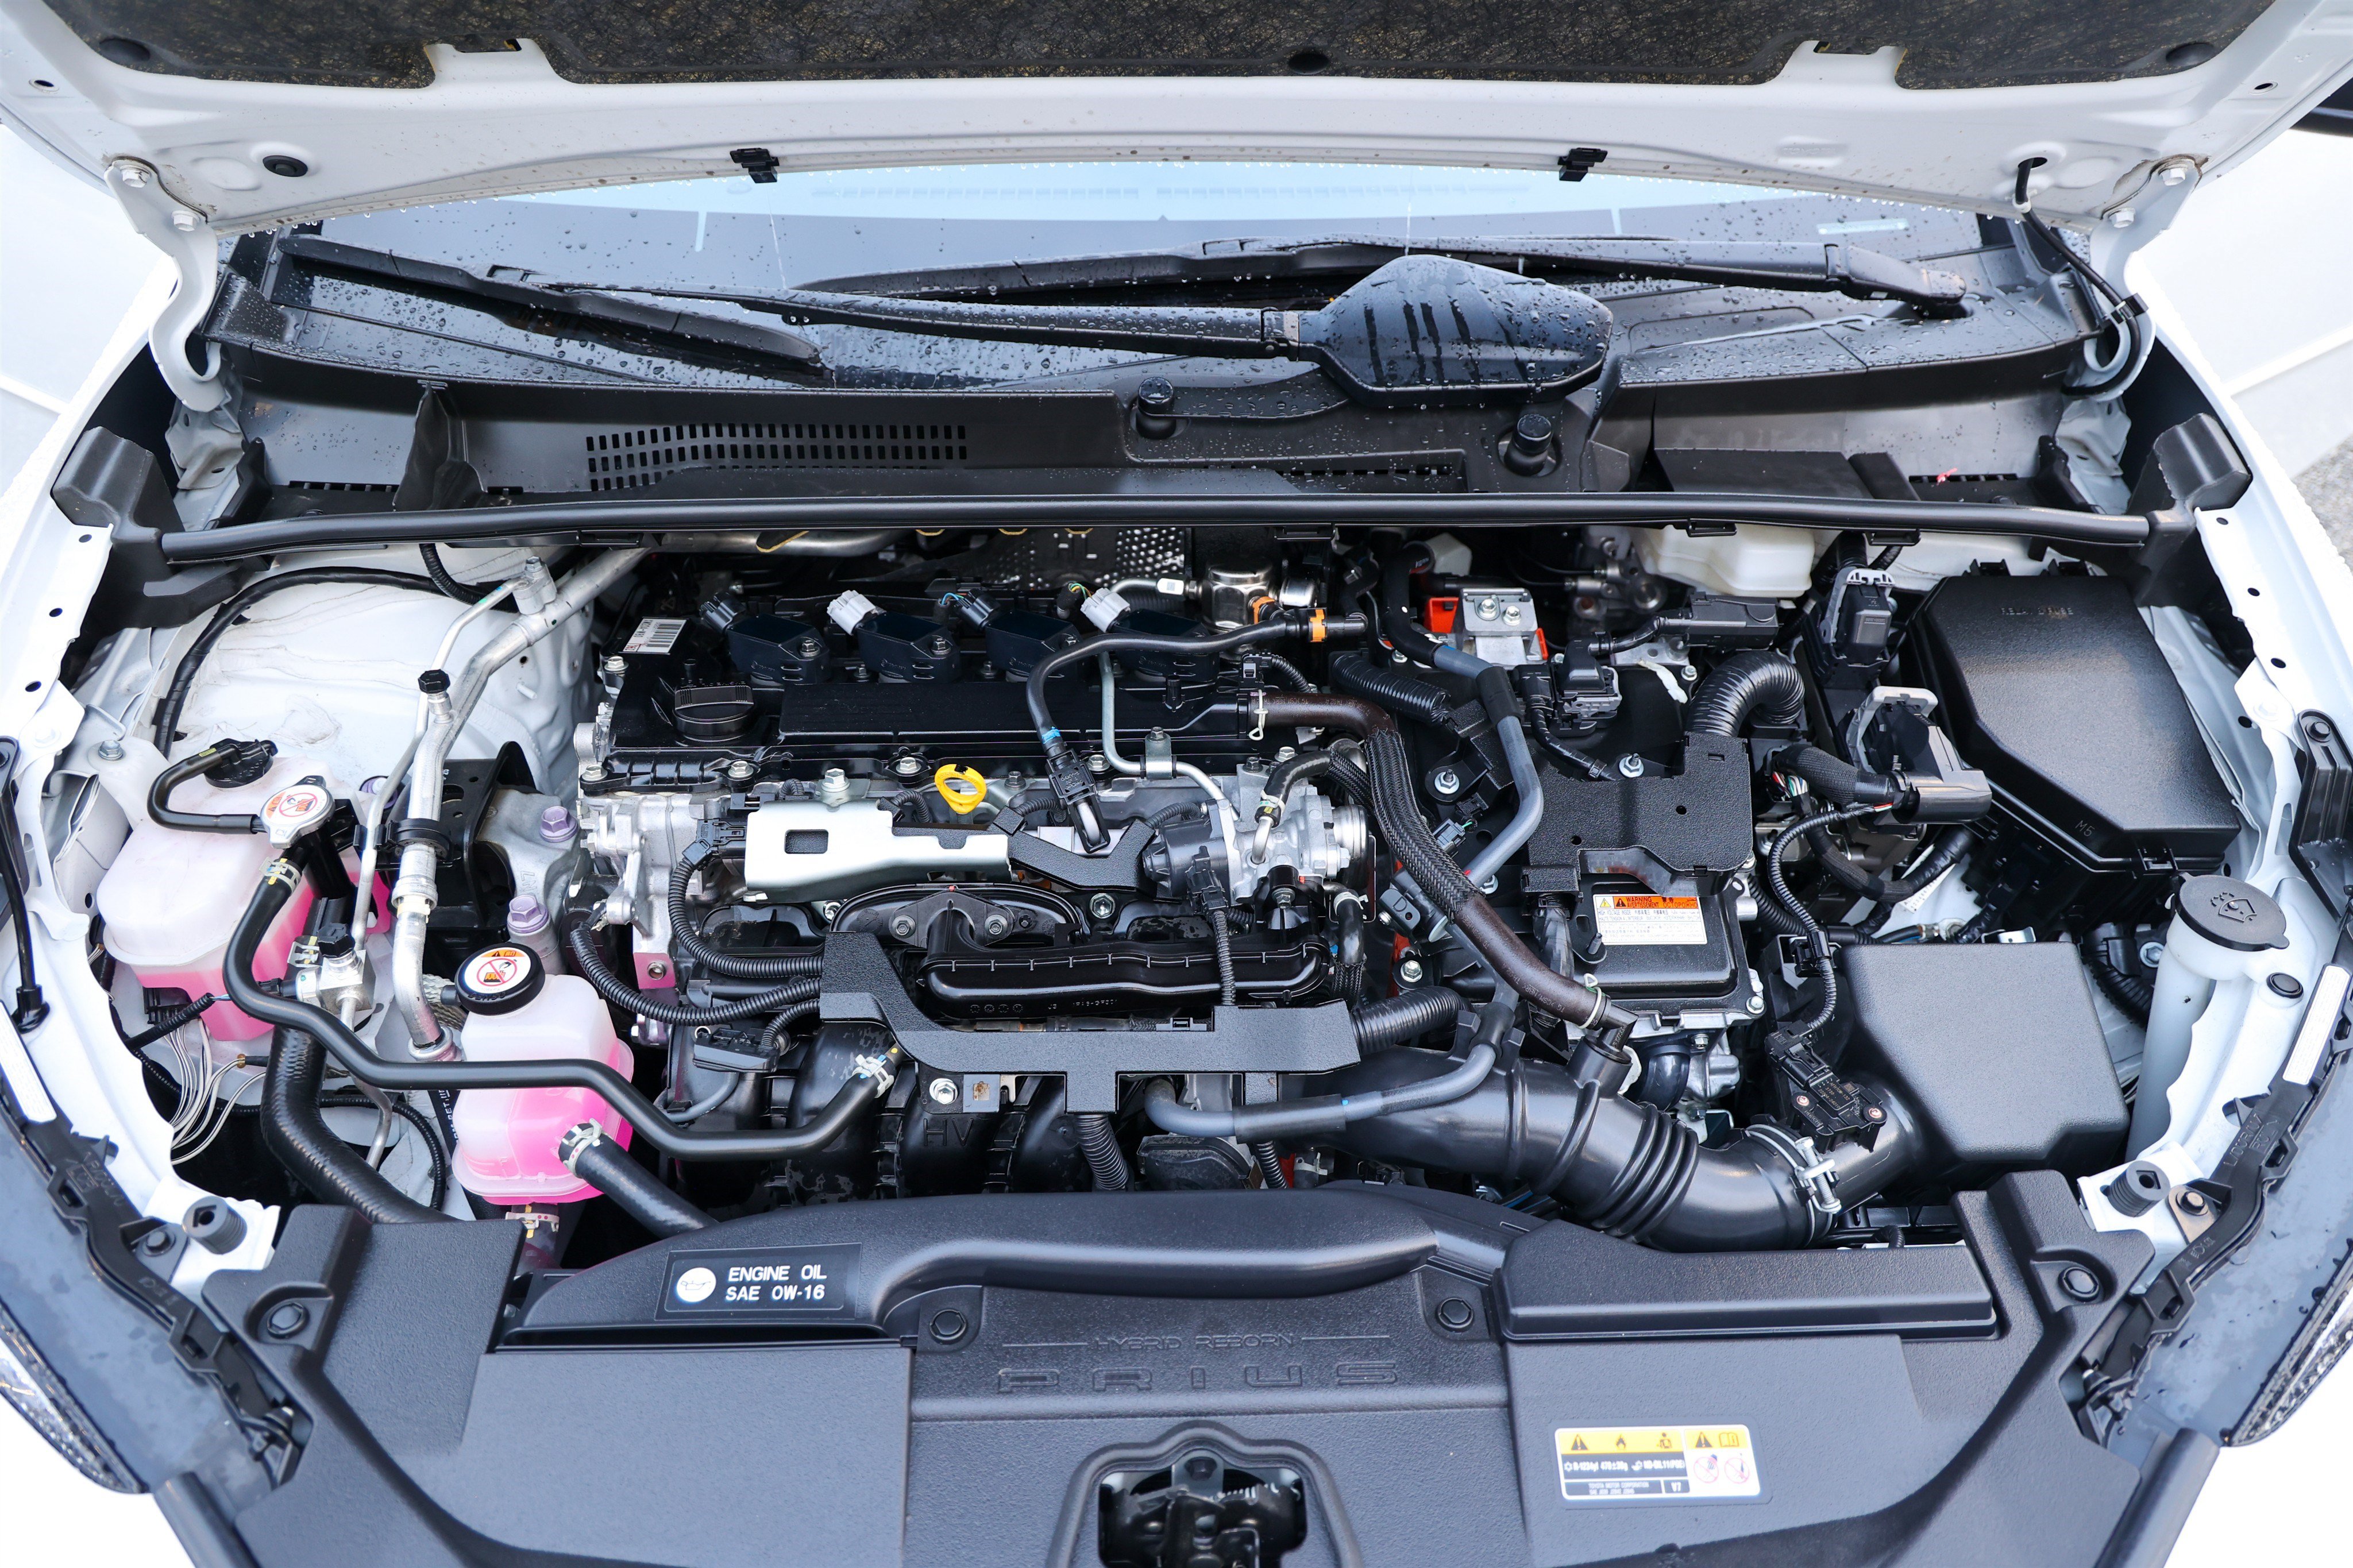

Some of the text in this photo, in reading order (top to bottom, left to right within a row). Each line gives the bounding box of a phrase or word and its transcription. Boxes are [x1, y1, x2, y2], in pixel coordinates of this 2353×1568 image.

[1392, 895, 1408, 913] D
[923, 1118, 974, 1146] HV
[728, 1264, 827, 1282] ENGINE OIL
[725, 1284, 825, 1301] SAE 0W-16
[1096, 1331, 1294, 1352] HYBRID REBORN
[997, 1362, 1398, 1393] PRIUS
